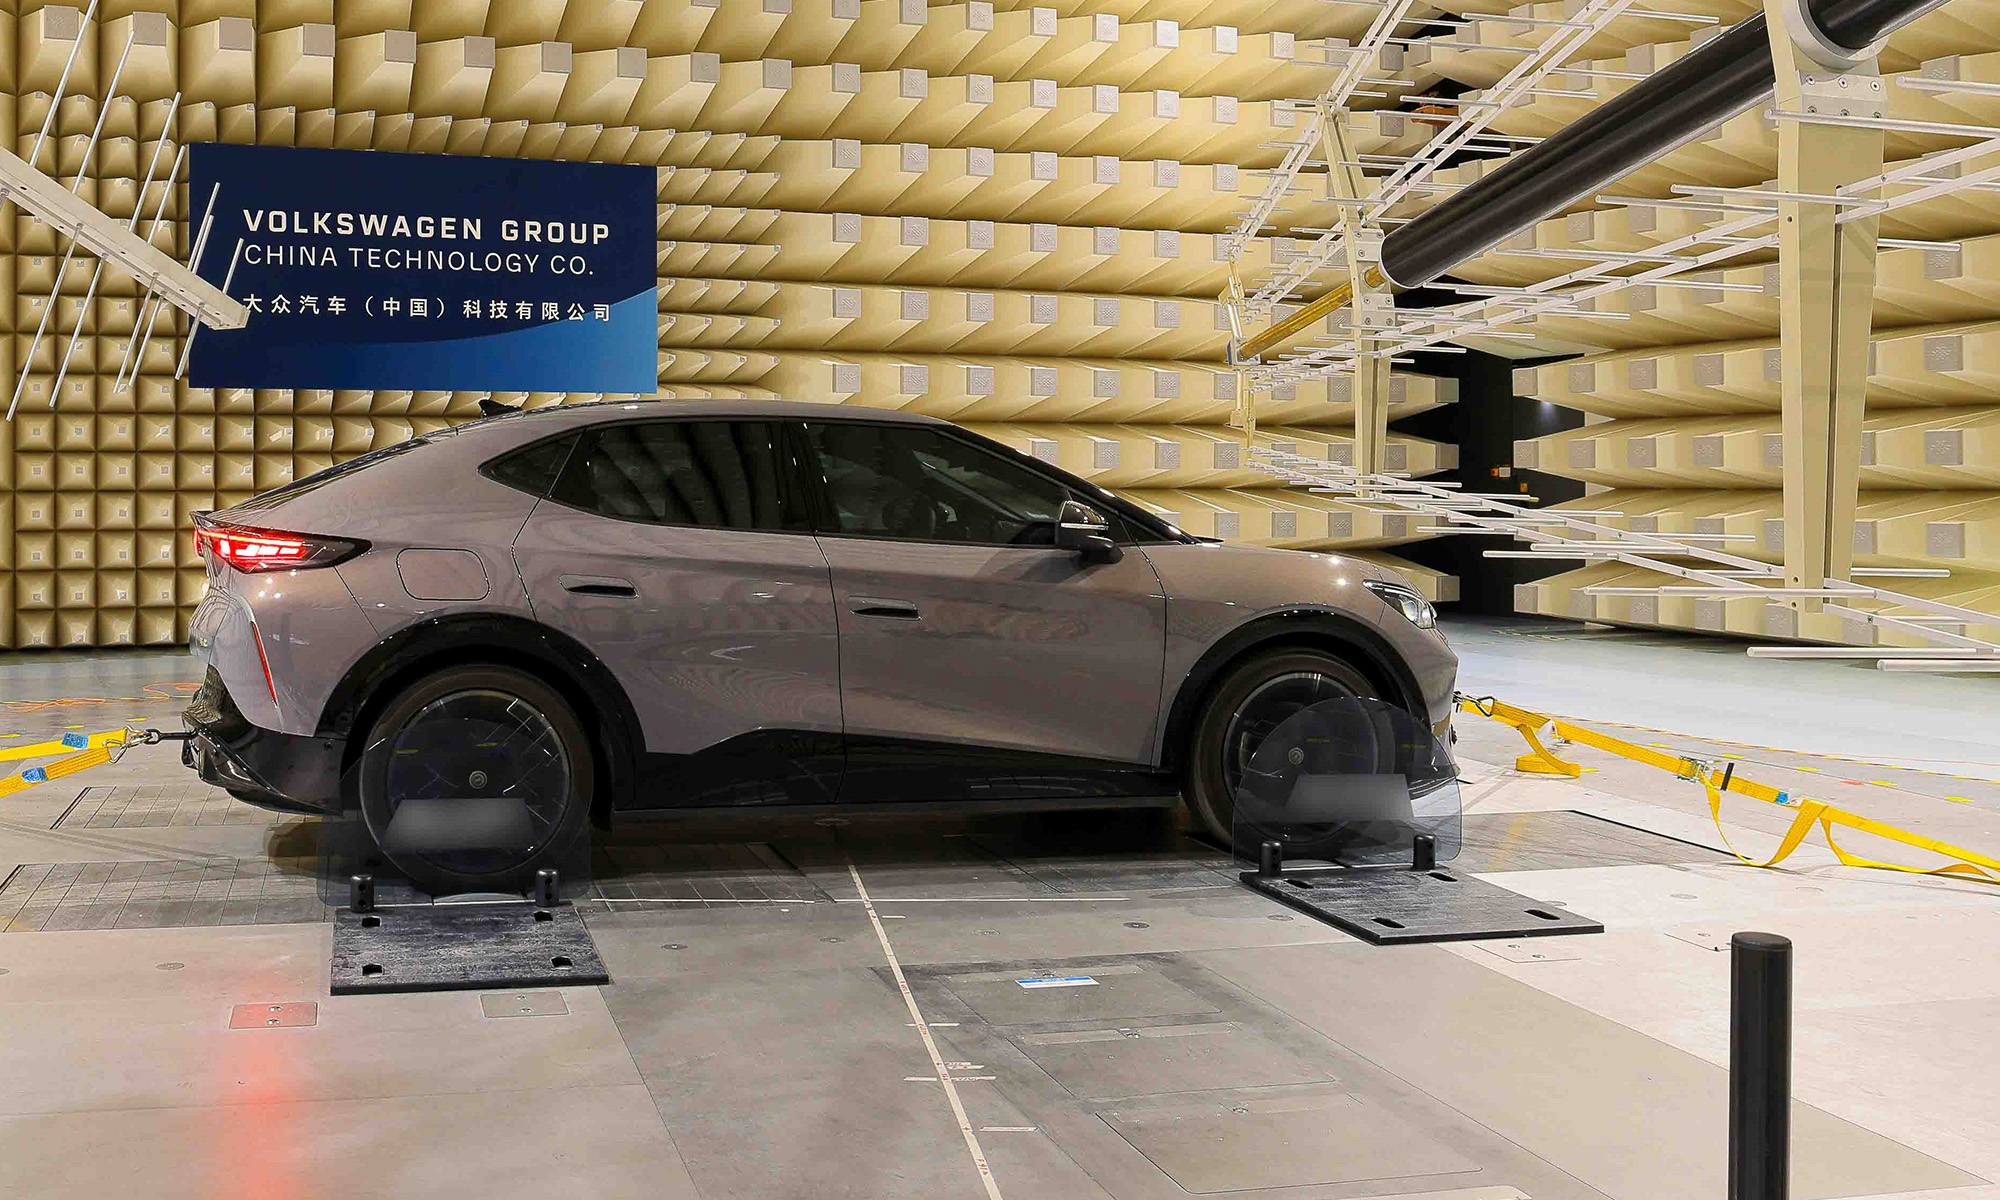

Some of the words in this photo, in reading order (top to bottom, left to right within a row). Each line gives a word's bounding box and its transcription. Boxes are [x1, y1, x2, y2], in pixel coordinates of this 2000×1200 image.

[242, 208, 482, 241] VOLKSWAGEN
[501, 218, 610, 246] GROUP
[243, 243, 338, 268] CHINA
[348, 247, 540, 274] TECHNOLOGY
[549, 254, 594, 276] CO.
[242, 292, 611, 323] 大众汽车（中国）科技有限公司
